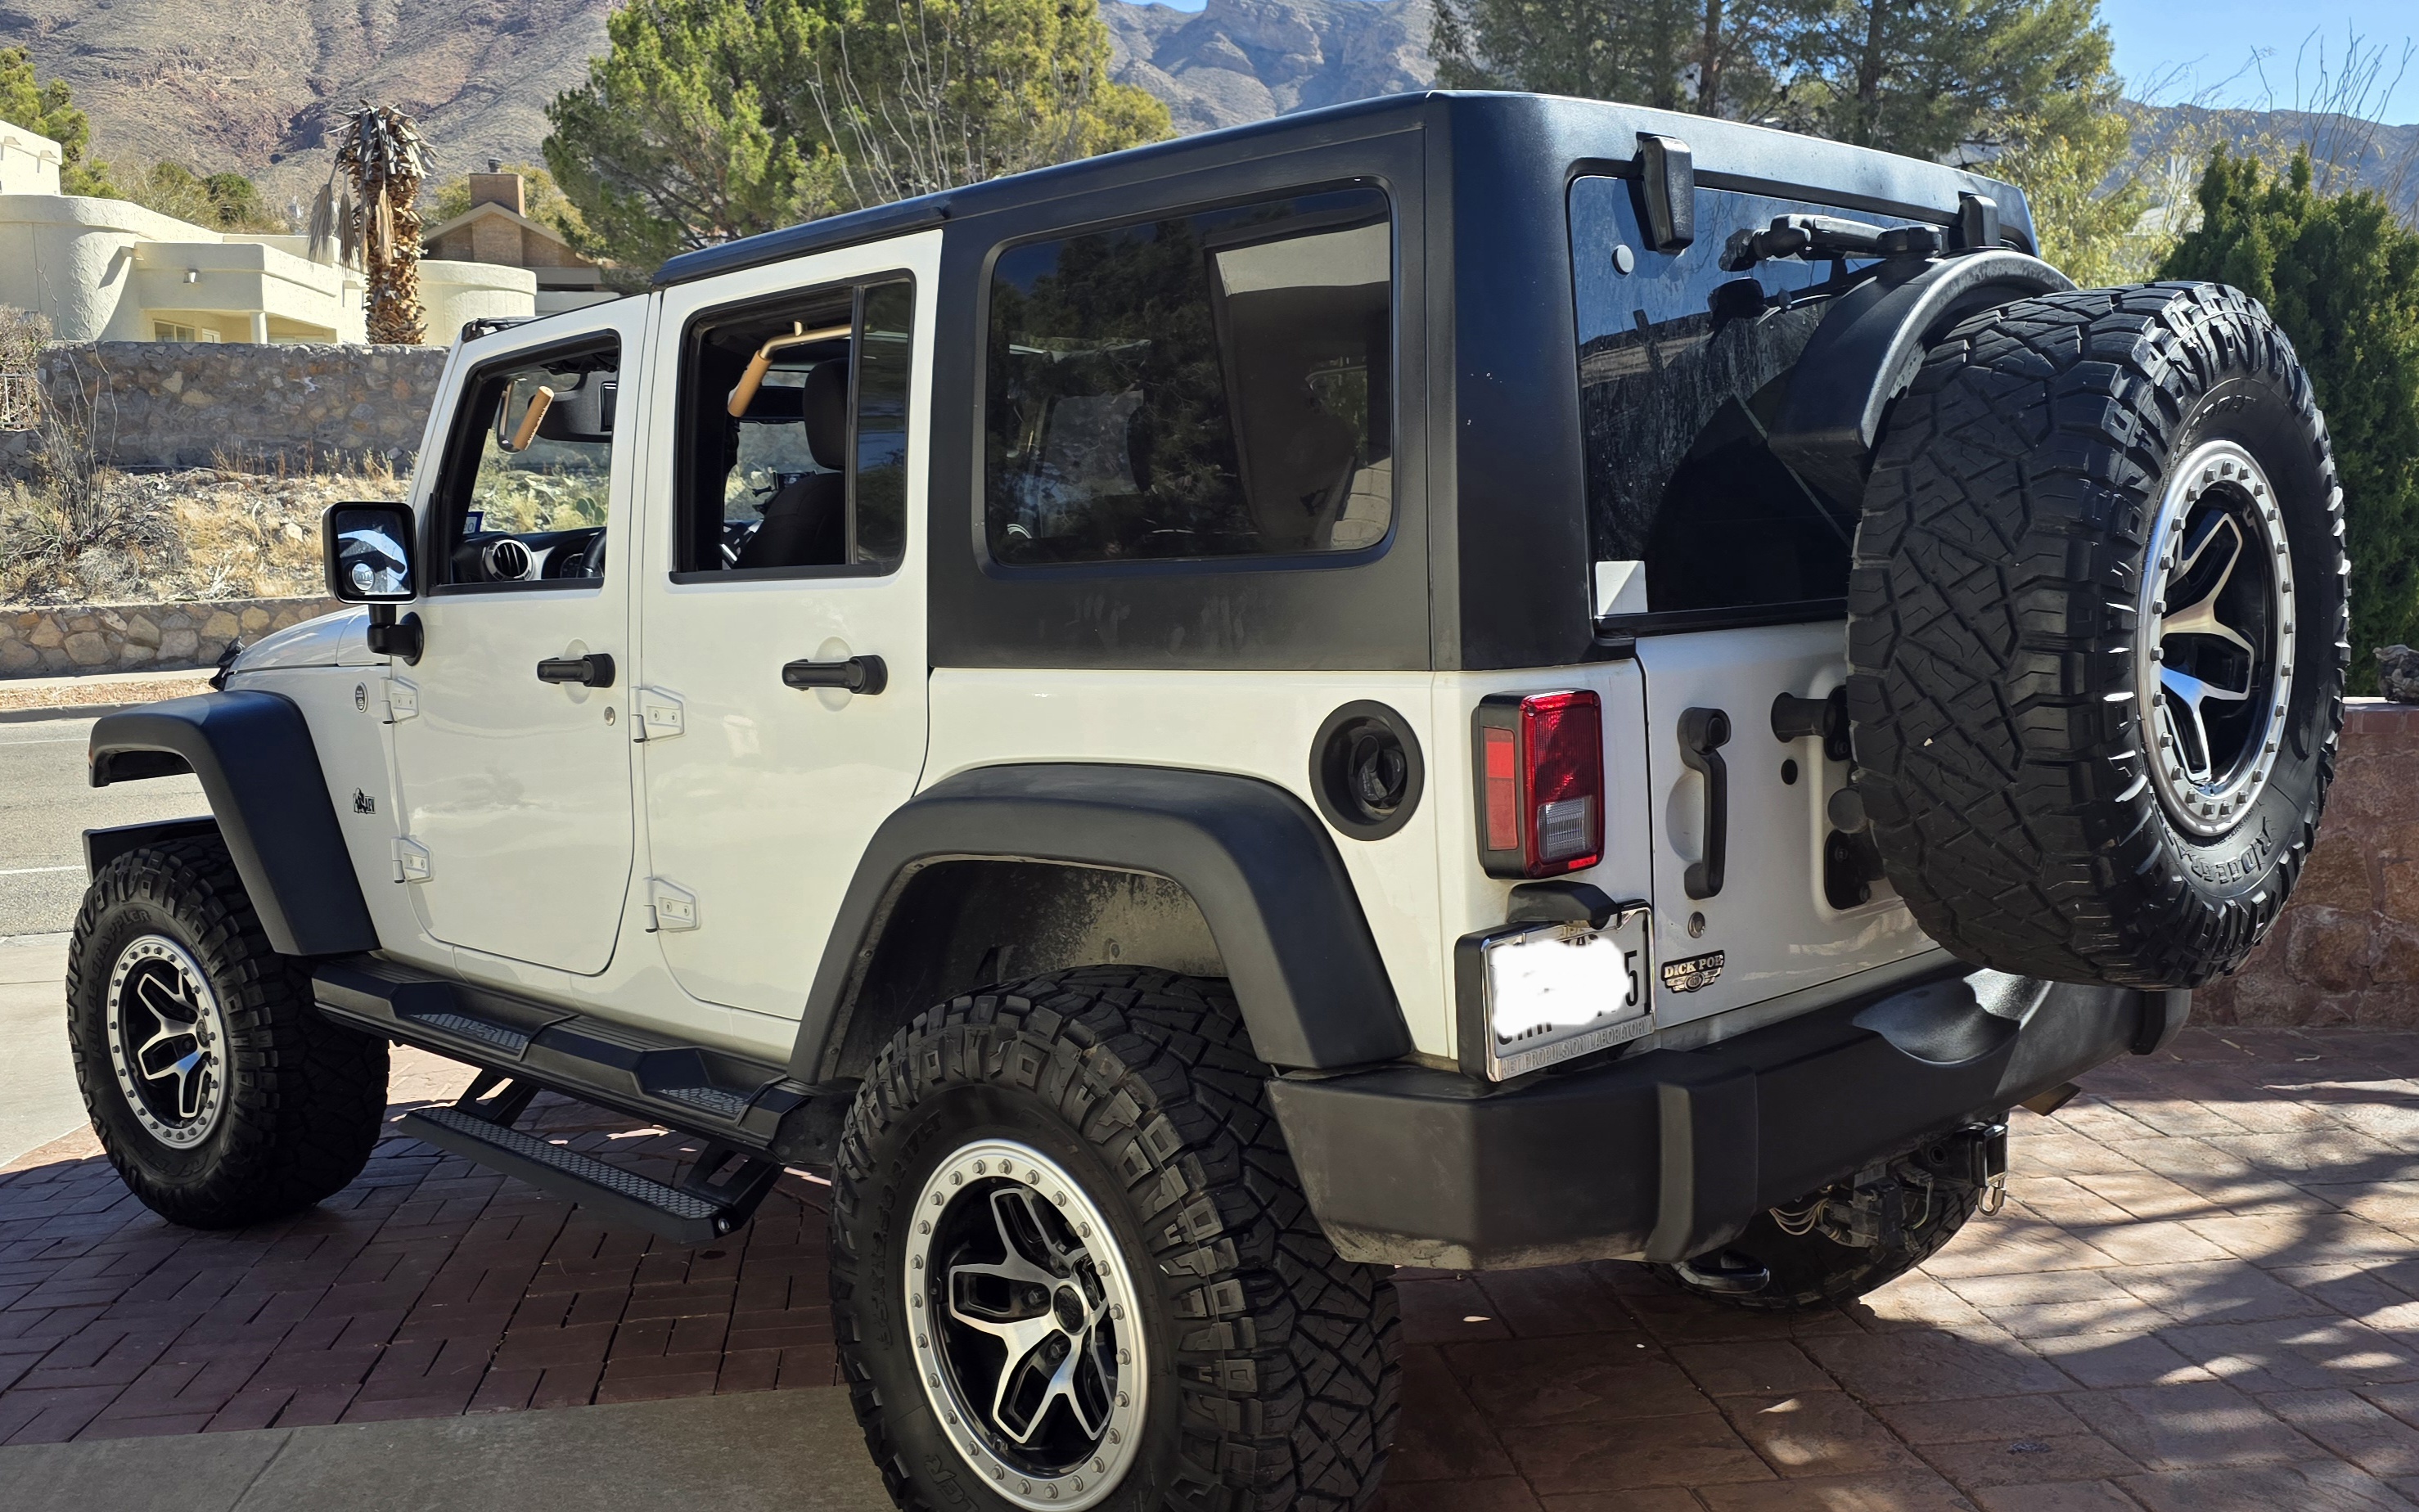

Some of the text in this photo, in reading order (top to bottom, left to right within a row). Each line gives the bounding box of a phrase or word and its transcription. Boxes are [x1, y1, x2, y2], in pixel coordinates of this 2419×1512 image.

[1664, 954, 1724, 979] DICK POE
[1503, 1055, 1523, 1075] JET
[1524, 1037, 1586, 1069] PROPULSION
